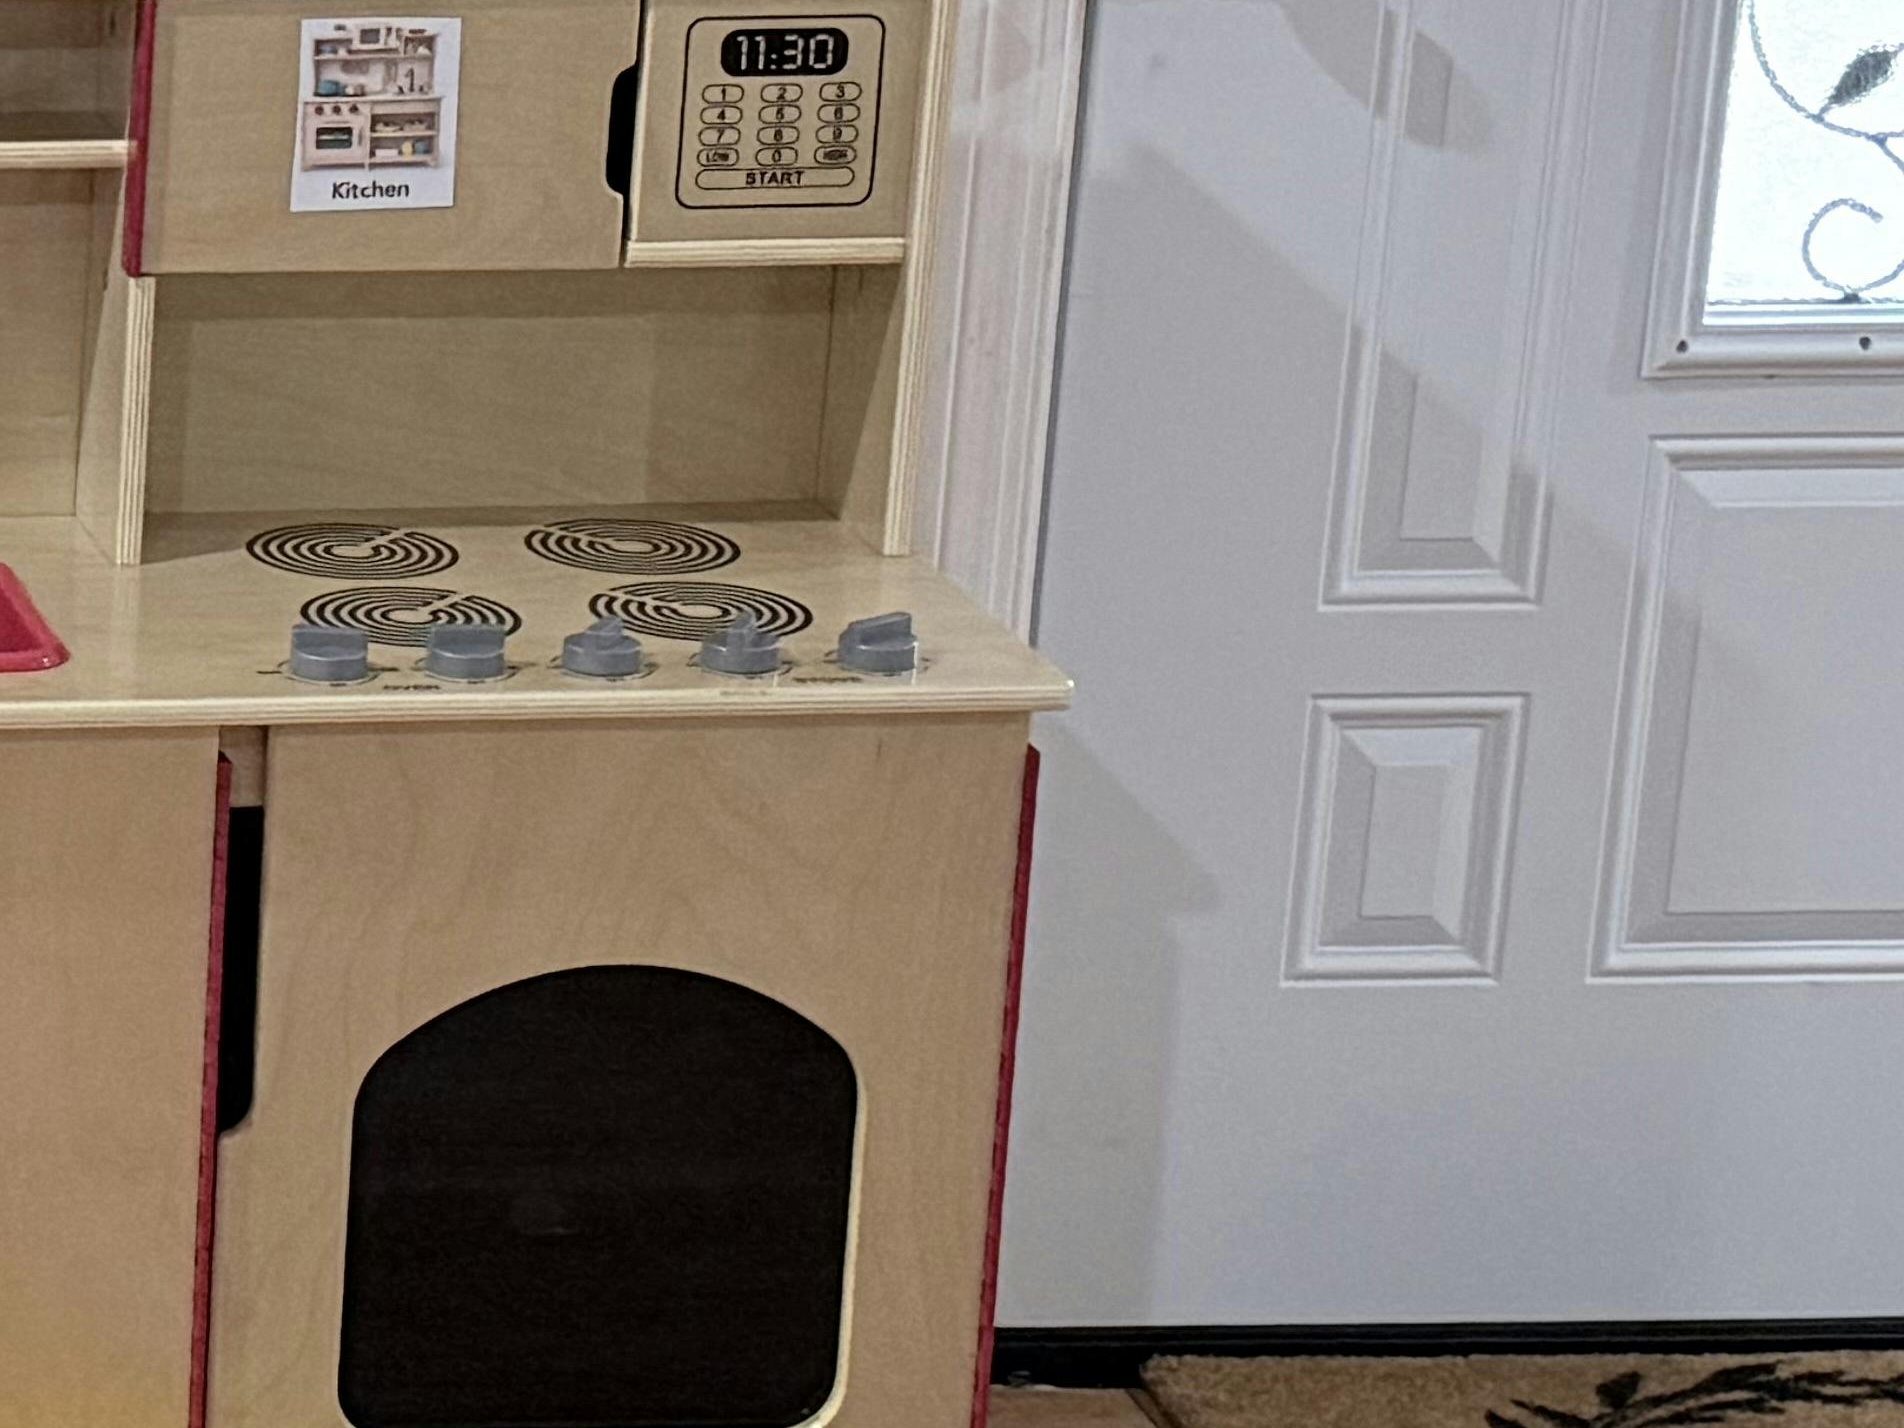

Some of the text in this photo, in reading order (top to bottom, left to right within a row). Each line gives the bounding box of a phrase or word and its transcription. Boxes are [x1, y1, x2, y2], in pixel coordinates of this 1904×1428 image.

[736, 33, 834, 71] 11:30
[721, 84, 846, 101] 1 2 3
[717, 108, 726, 121] 4
[716, 129, 725, 143] 7
[772, 149, 782, 163] 0
[745, 171, 805, 185] START
[331, 180, 411, 199] Kitchen
